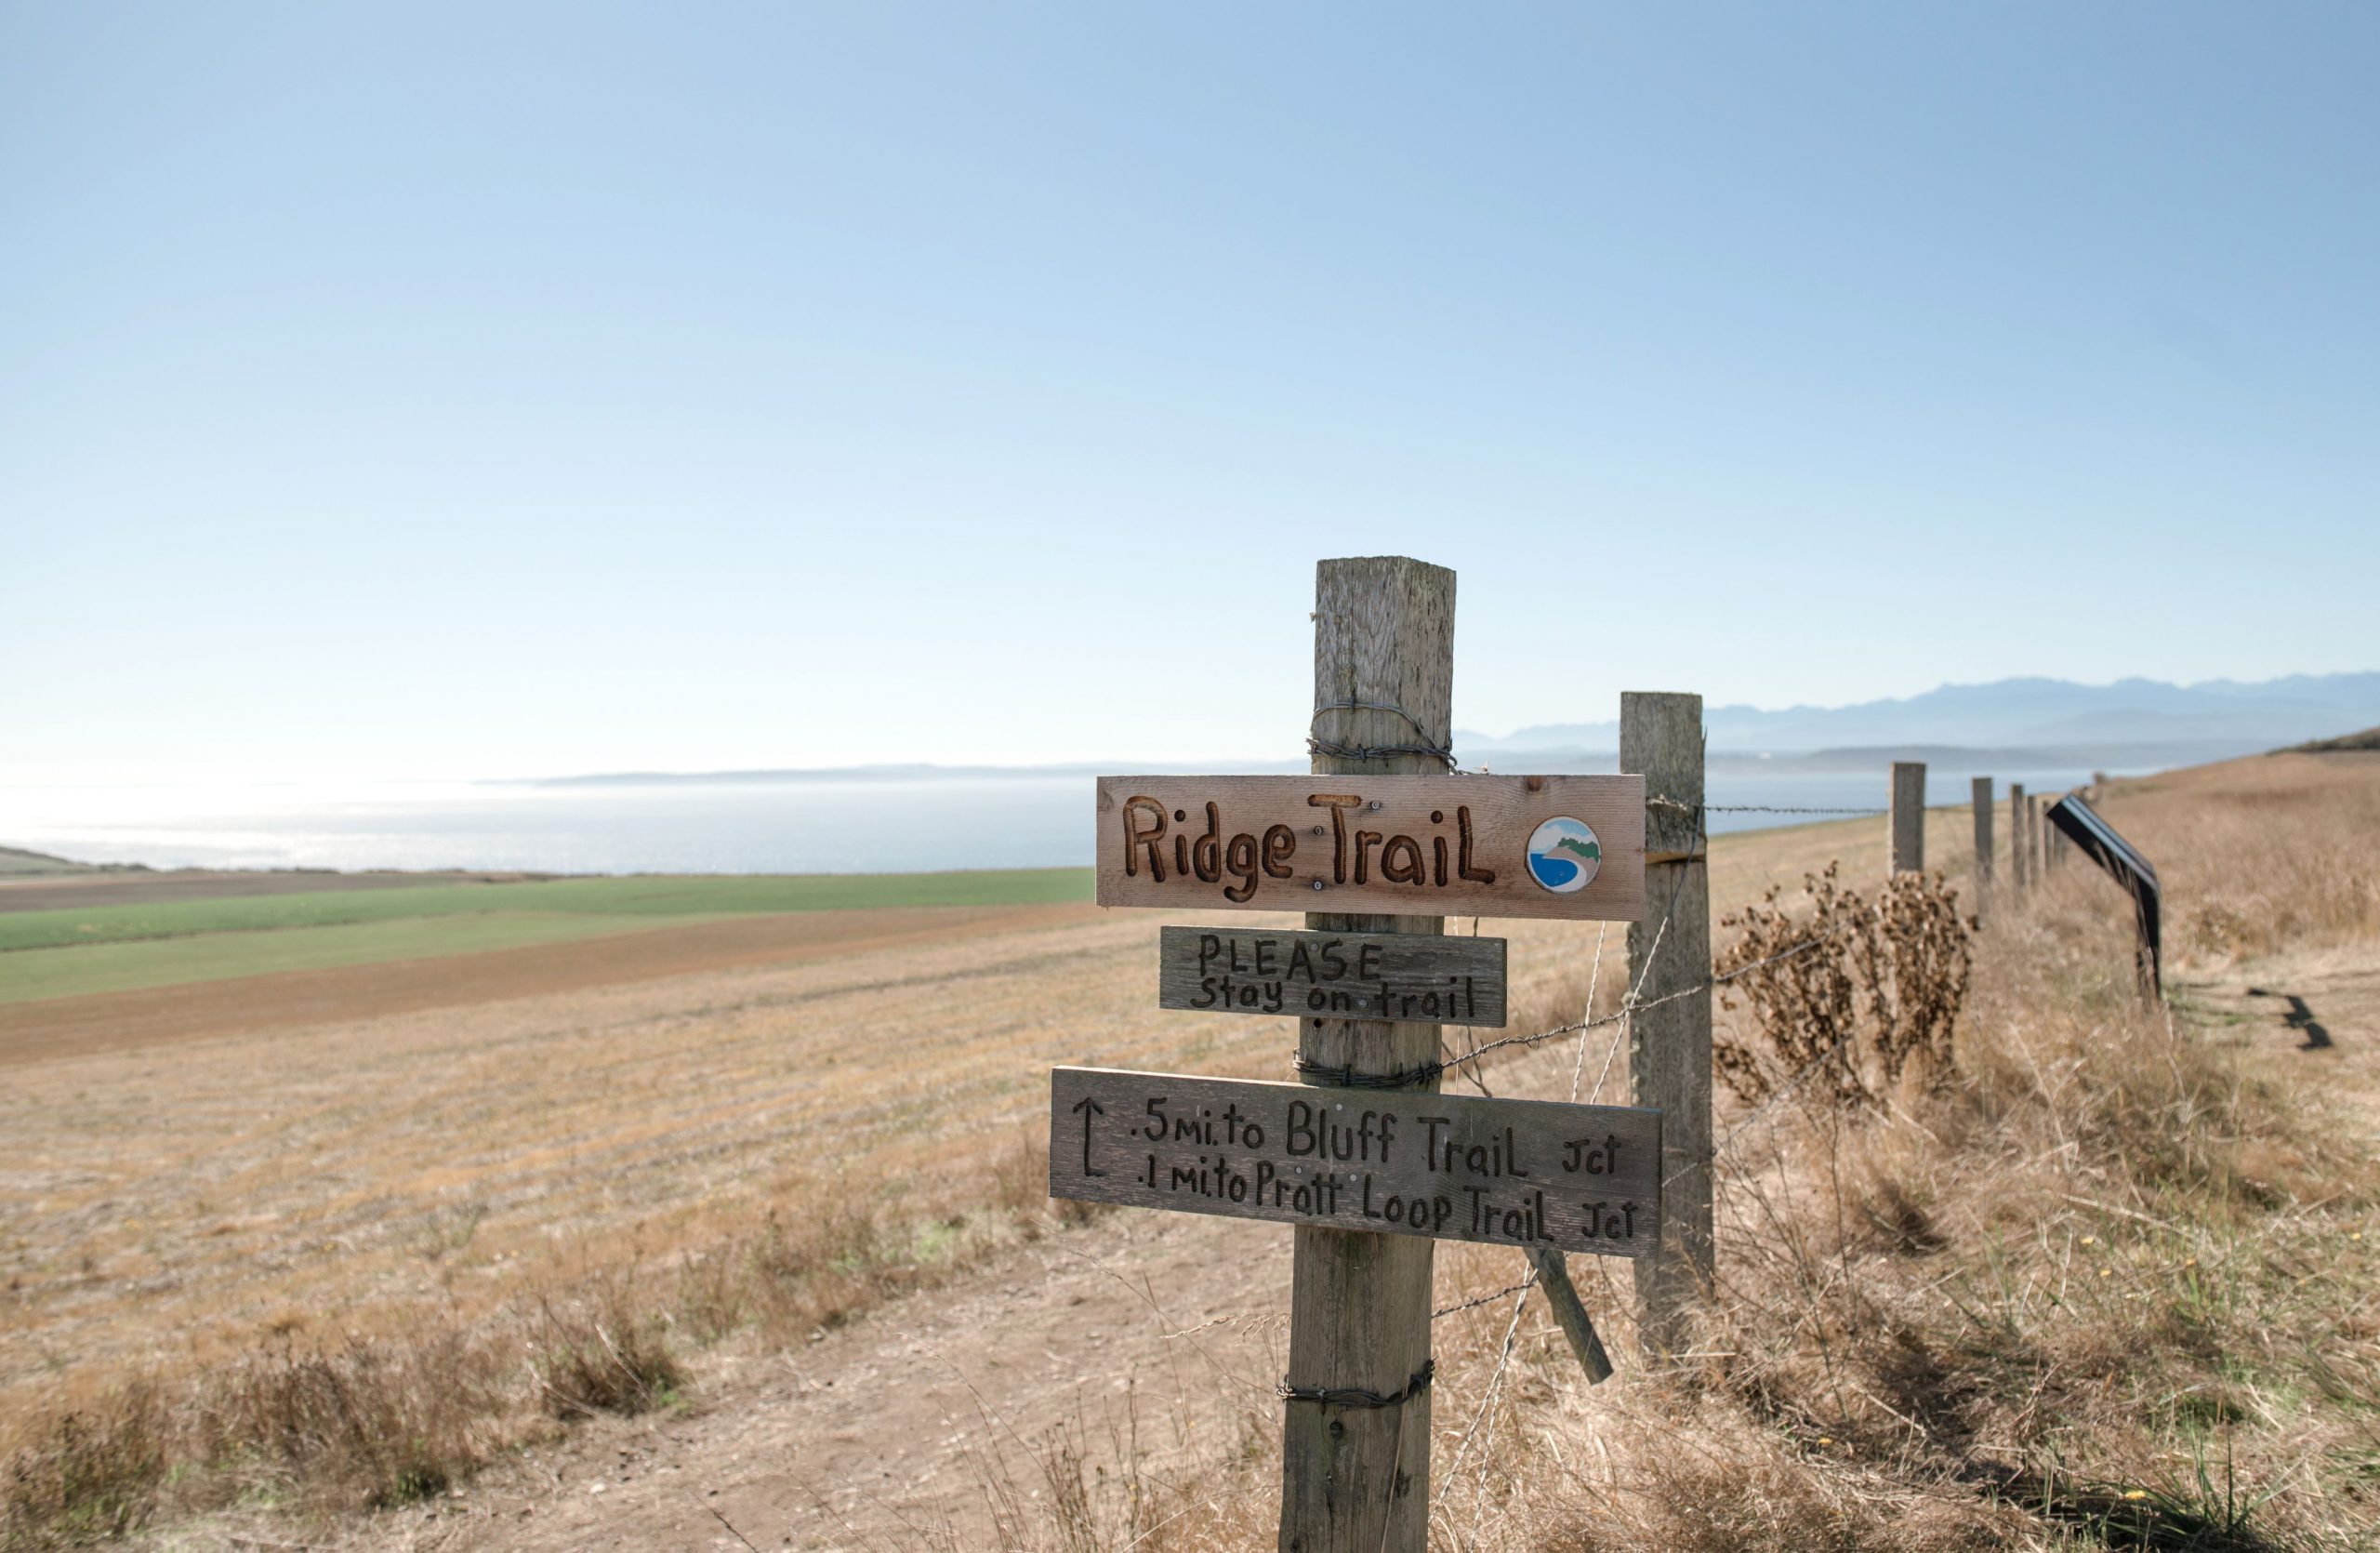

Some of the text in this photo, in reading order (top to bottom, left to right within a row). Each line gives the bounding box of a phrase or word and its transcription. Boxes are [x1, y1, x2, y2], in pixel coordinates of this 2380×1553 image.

[1122, 795, 1296, 902] Ridge
[1190, 976, 1474, 1018] Stay on trail
[1198, 935, 1383, 984] PLEASE
[1287, 1100, 1397, 1162] Bluff
[1562, 1135, 1622, 1175] Jct
[1256, 1161, 1342, 1215] Pratt
[1363, 1175, 1452, 1231] Loop
[1581, 1201, 1638, 1240] Jct
